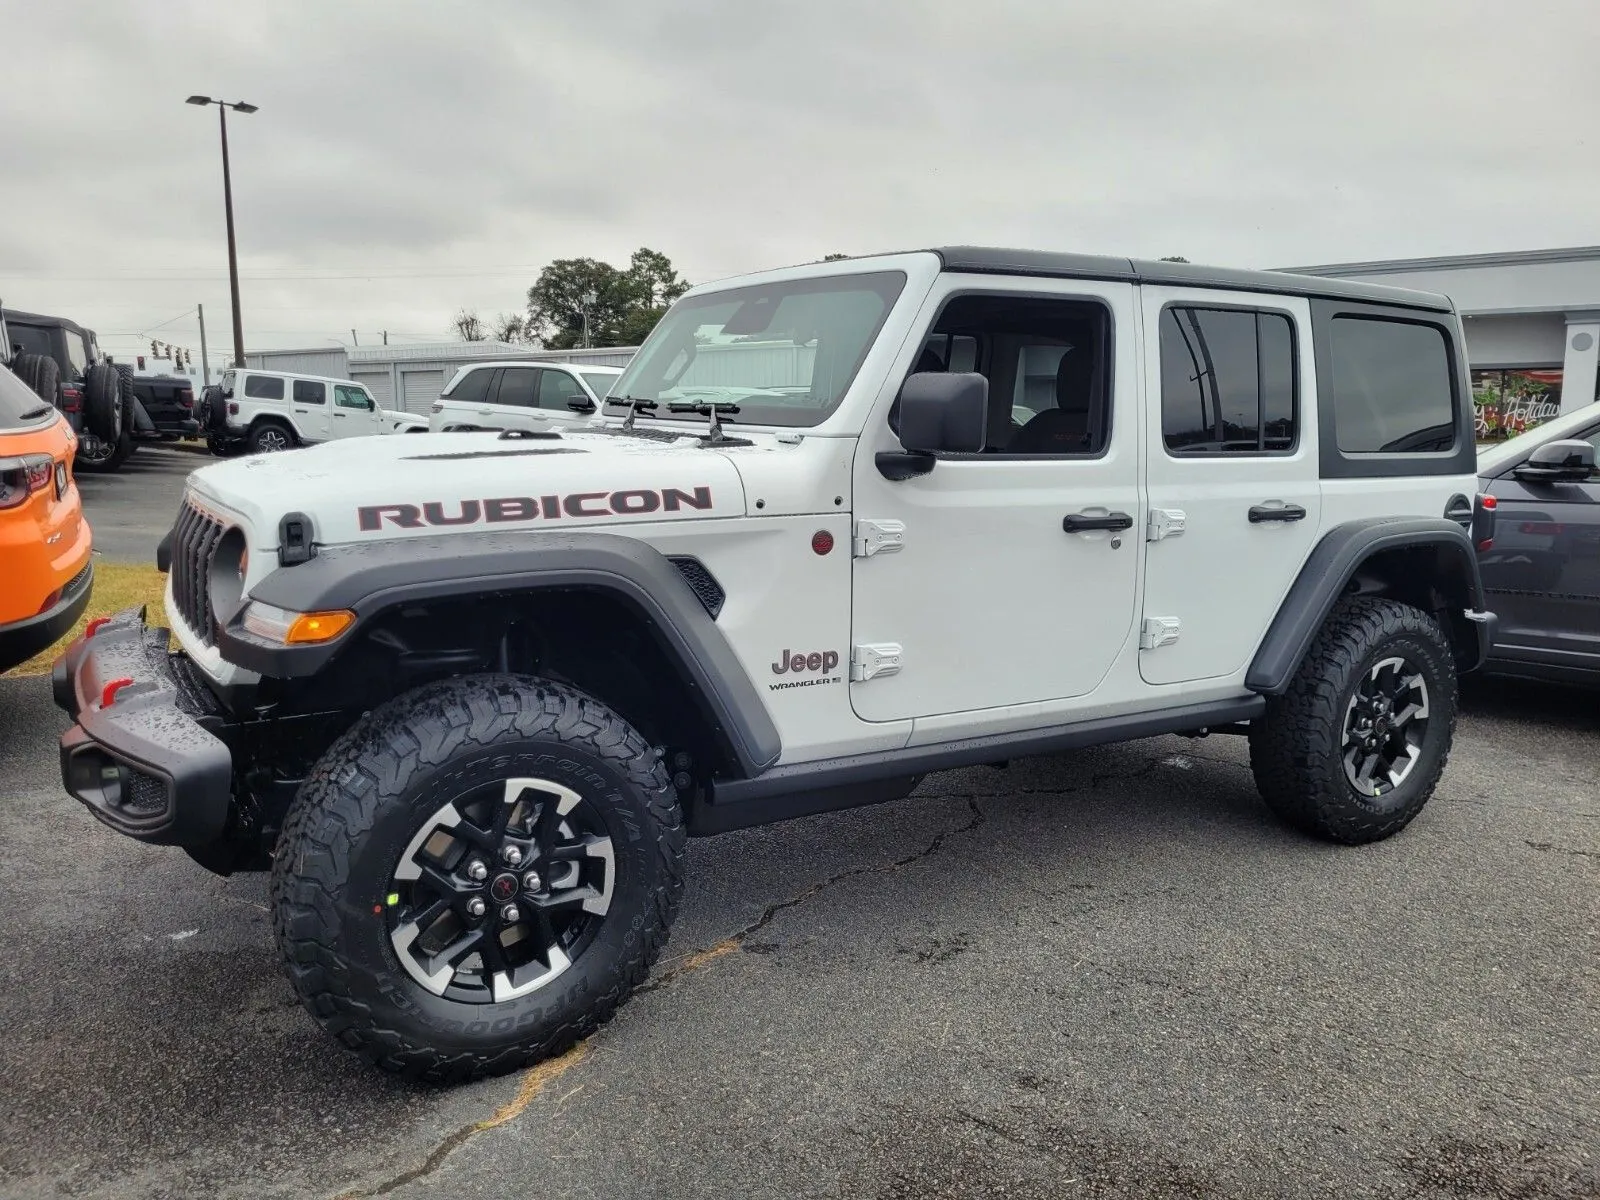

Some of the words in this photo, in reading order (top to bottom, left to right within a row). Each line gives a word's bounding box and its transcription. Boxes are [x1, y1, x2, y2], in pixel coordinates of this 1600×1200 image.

[358, 486, 713, 531] RUBICON
[771, 648, 839, 674] Jeep
[768, 678, 830, 691] WRANGLER
